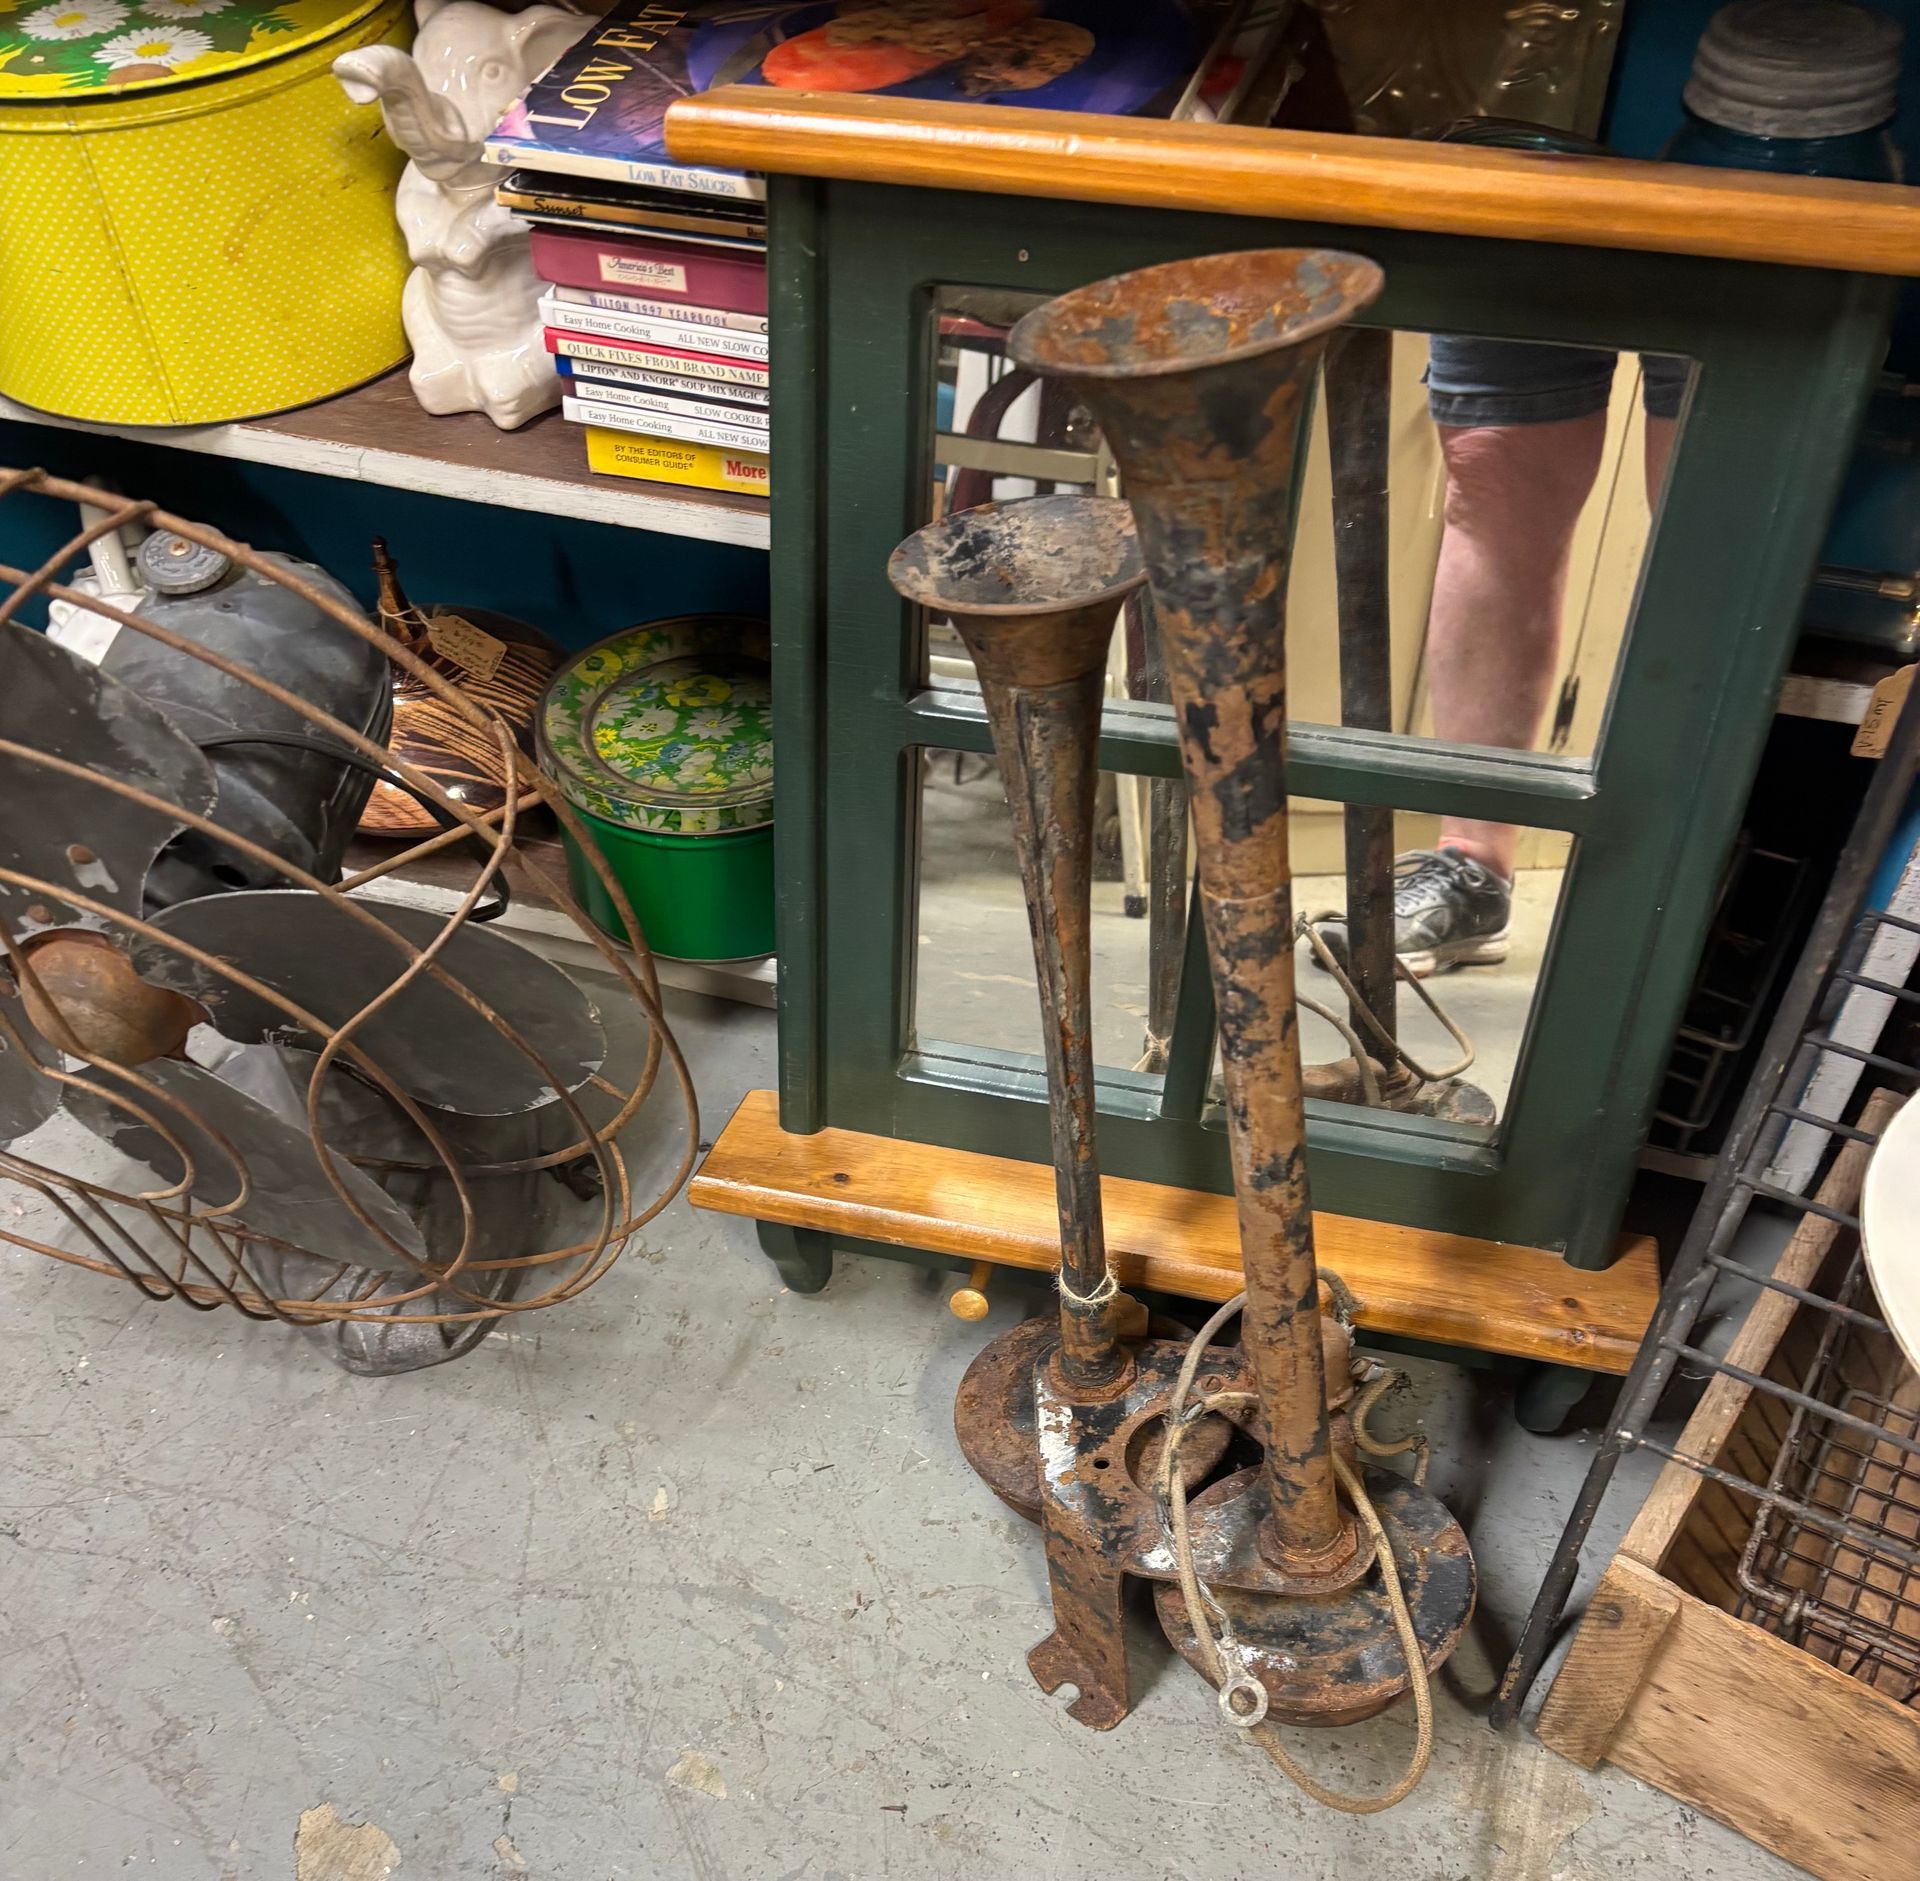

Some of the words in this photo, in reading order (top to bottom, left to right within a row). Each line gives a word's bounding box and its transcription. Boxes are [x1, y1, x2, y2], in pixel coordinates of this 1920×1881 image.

[524, 57, 633, 130] LOW
[592, 4, 689, 51] FAT
[628, 165, 656, 181] LOW
[661, 169, 684, 186] FAT
[688, 173, 737, 194] SAUCES
[533, 198, 586, 217] Sunset
[607, 257, 653, 274] America's
[655, 264, 676, 276] Best
[589, 295, 630, 311] WILTON
[636, 303, 663, 316] 1997
[669, 308, 728, 327] YEARBOOK
[563, 314, 582, 325] Easy
[585, 318, 612, 330] Home
[614, 323, 651, 339] Cooking
[677, 333, 696, 344] ALL
[698, 336, 720, 348] NEW
[722, 340, 751, 354] SLOW
[567, 342, 605, 358] QUICK
[609, 350, 642, 364] FIXES
[645, 355, 680, 370] FROM
[683, 362, 726, 377] BRAND
[728, 368, 765, 384] NAME
[621, 370, 640, 380] AND
[681, 380, 706, 391] SOUP
[707, 384, 727, 395] MIX
[728, 388, 760, 401] MAGIC
[585, 386, 604, 398] Easy
[605, 390, 632, 402] Home
[633, 395, 669, 410] Cooking
[694, 405, 722, 418] SLOW
[723, 411, 763, 425] COOKER
[588, 410, 607, 421] Easy
[609, 414, 635, 426] Home
[636, 419, 672, 433] Cooking
[698, 429, 715, 439] ALL
[717, 432, 739, 443] NEW
[740, 436, 769, 448] SLOW
[614, 444, 625, 452] BY
[628, 446, 645, 455] THE
[647, 448, 683, 460] EDITORS
[685, 453, 697, 461] OF
[615, 454, 661, 466] CONSUMER
[726, 459, 767, 480] More
